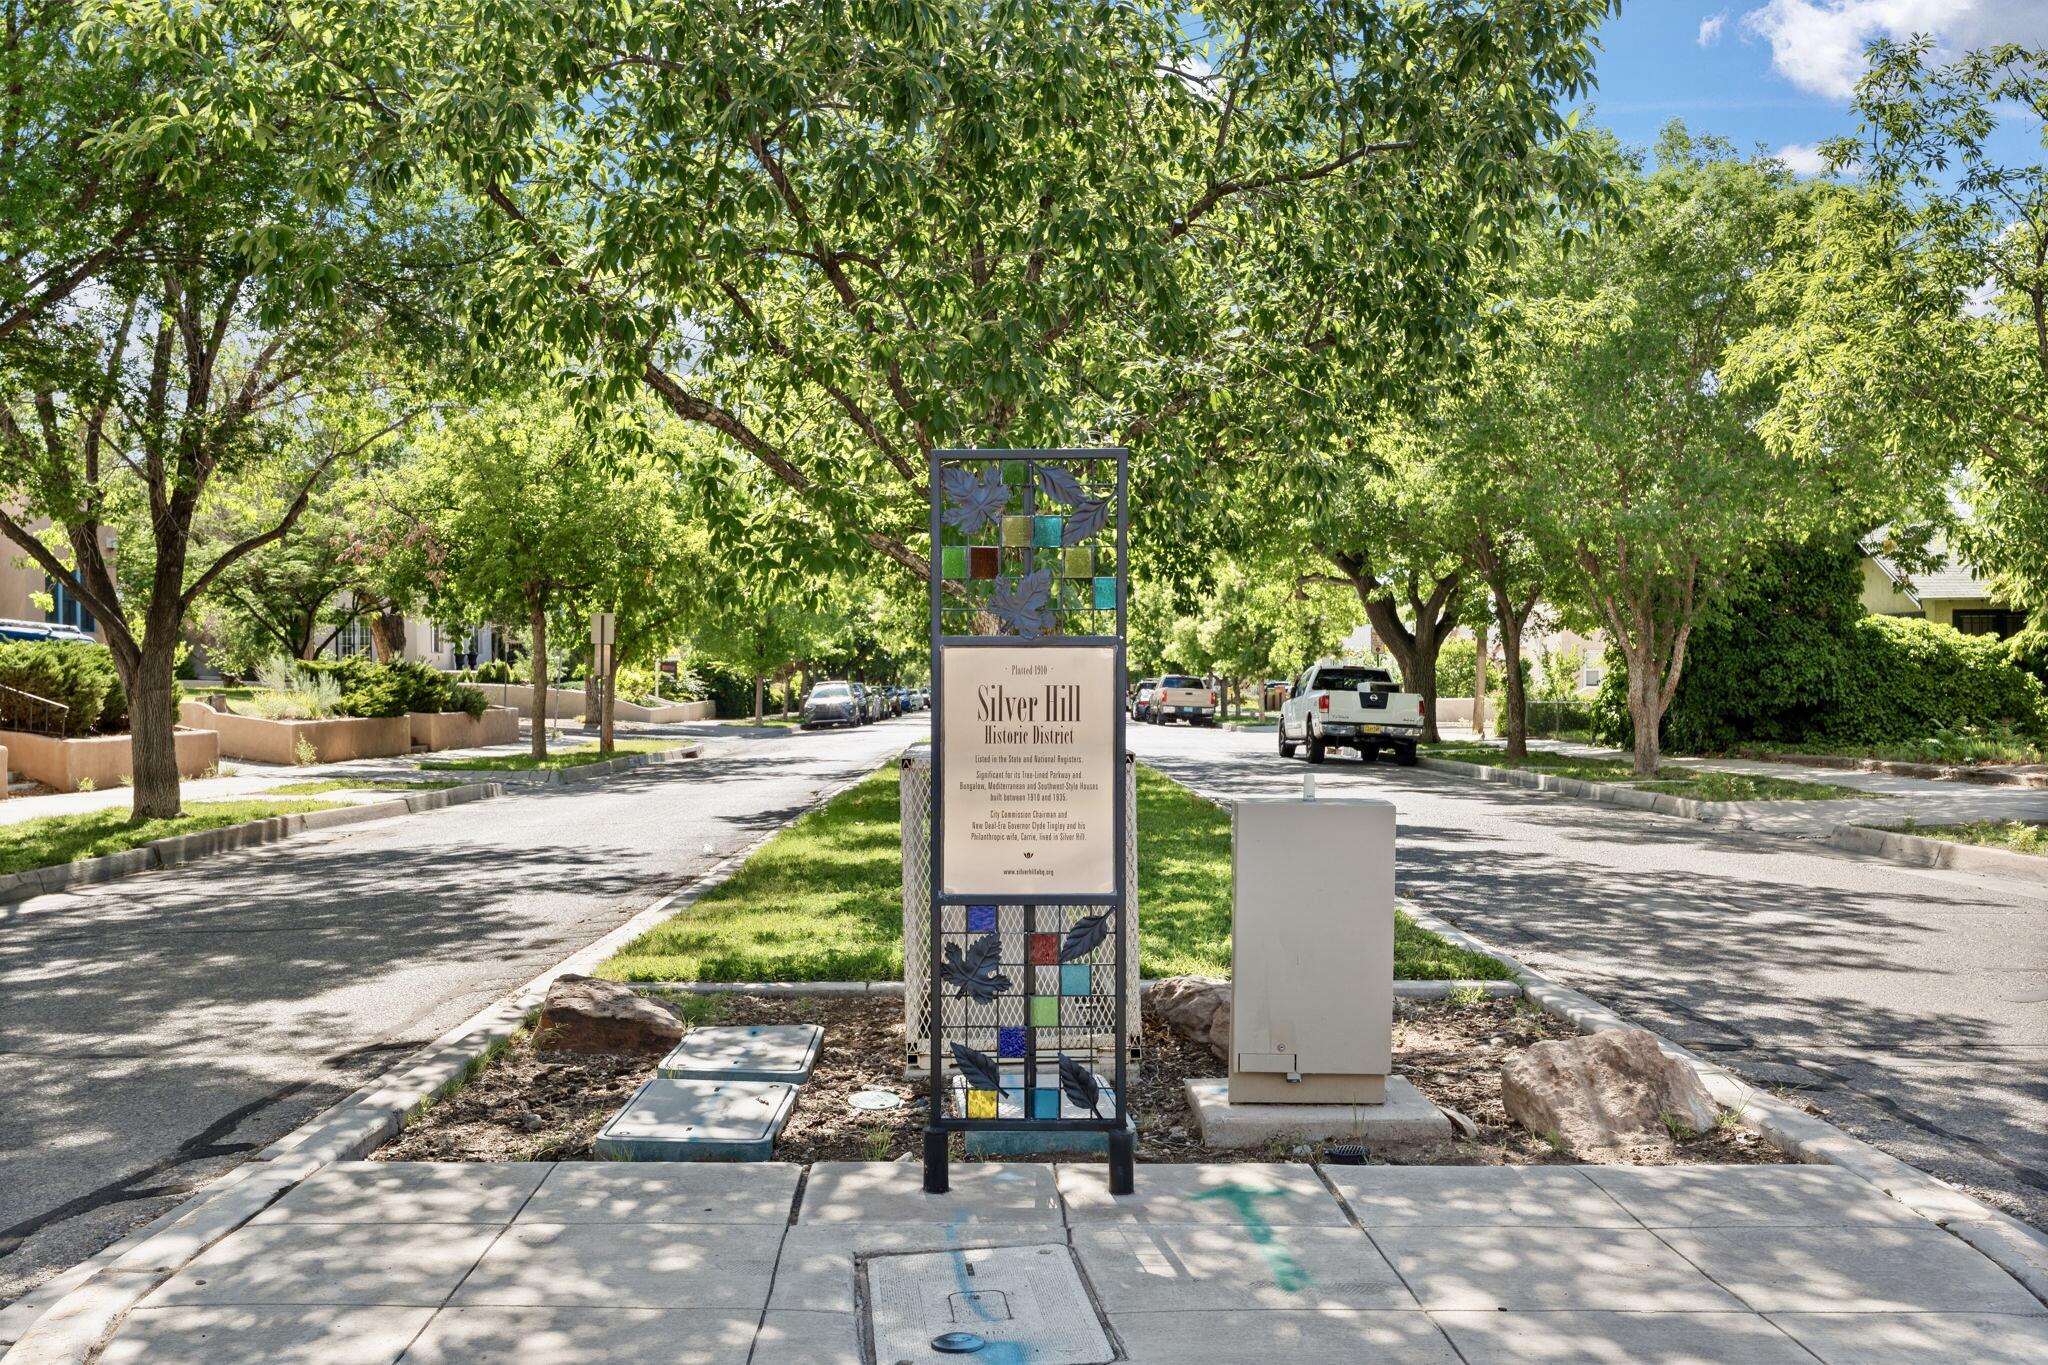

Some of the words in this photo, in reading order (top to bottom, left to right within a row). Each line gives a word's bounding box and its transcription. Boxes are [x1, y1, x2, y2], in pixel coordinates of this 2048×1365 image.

[1011, 665, 1033, 675] Platted
[977, 684, 1038, 722] Silver
[1044, 684, 1081, 722] Hill
[985, 725, 1029, 744] Historic
[1033, 725, 1074, 744] District
[975, 755, 991, 763] Listed
[992, 755, 997, 763] in
[998, 755, 1008, 763] the
[1008, 755, 1021, 763] State
[1023, 755, 1033, 763] and
[1034, 755, 1056, 763] National
[976, 771, 1004, 780] Significant
[1005, 771, 1013, 779] for
[1021, 771, 1049, 779] Tree-Lined
[1050, 771, 1071, 780] Parkway
[1072, 771, 1082, 779] and
[959, 782, 986, 791] Bungalow,
[987, 782, 1026, 790] Mediterranean
[1027, 782, 1036, 790] and
[1037, 782, 1078, 791] Southwest-Style
[1080, 782, 1099, 790] Houses
[990, 793, 1002, 801] built
[1003, 793, 1026, 801] between
[1027, 793, 1040, 801] 1910
[1041, 793, 1052, 801] and
[990, 810, 1000, 820] City
[1001, 810, 1031, 819] Commission
[1032, 810, 1057, 819] Chairman
[1058, 810, 1068, 819] and
[972, 822, 983, 830] New
[984, 822, 1006, 830] Deal-Era
[1007, 822, 1031, 830] Governor
[1031, 822, 1046, 831] Clyde
[1047, 822, 1066, 831] Tingley
[1067, 822, 1077, 830] and
[1077, 822, 1086, 830] his
[971, 833, 1005, 842] Philanthropic
[1006, 833, 1020, 842] wife,
[1020, 833, 1038, 842] Carrie,
[1039, 833, 1052, 841] lived
[1053, 833, 1059, 841] in
[1059, 833, 1074, 841] Silver
[1075, 833, 1087, 841] Hill.
